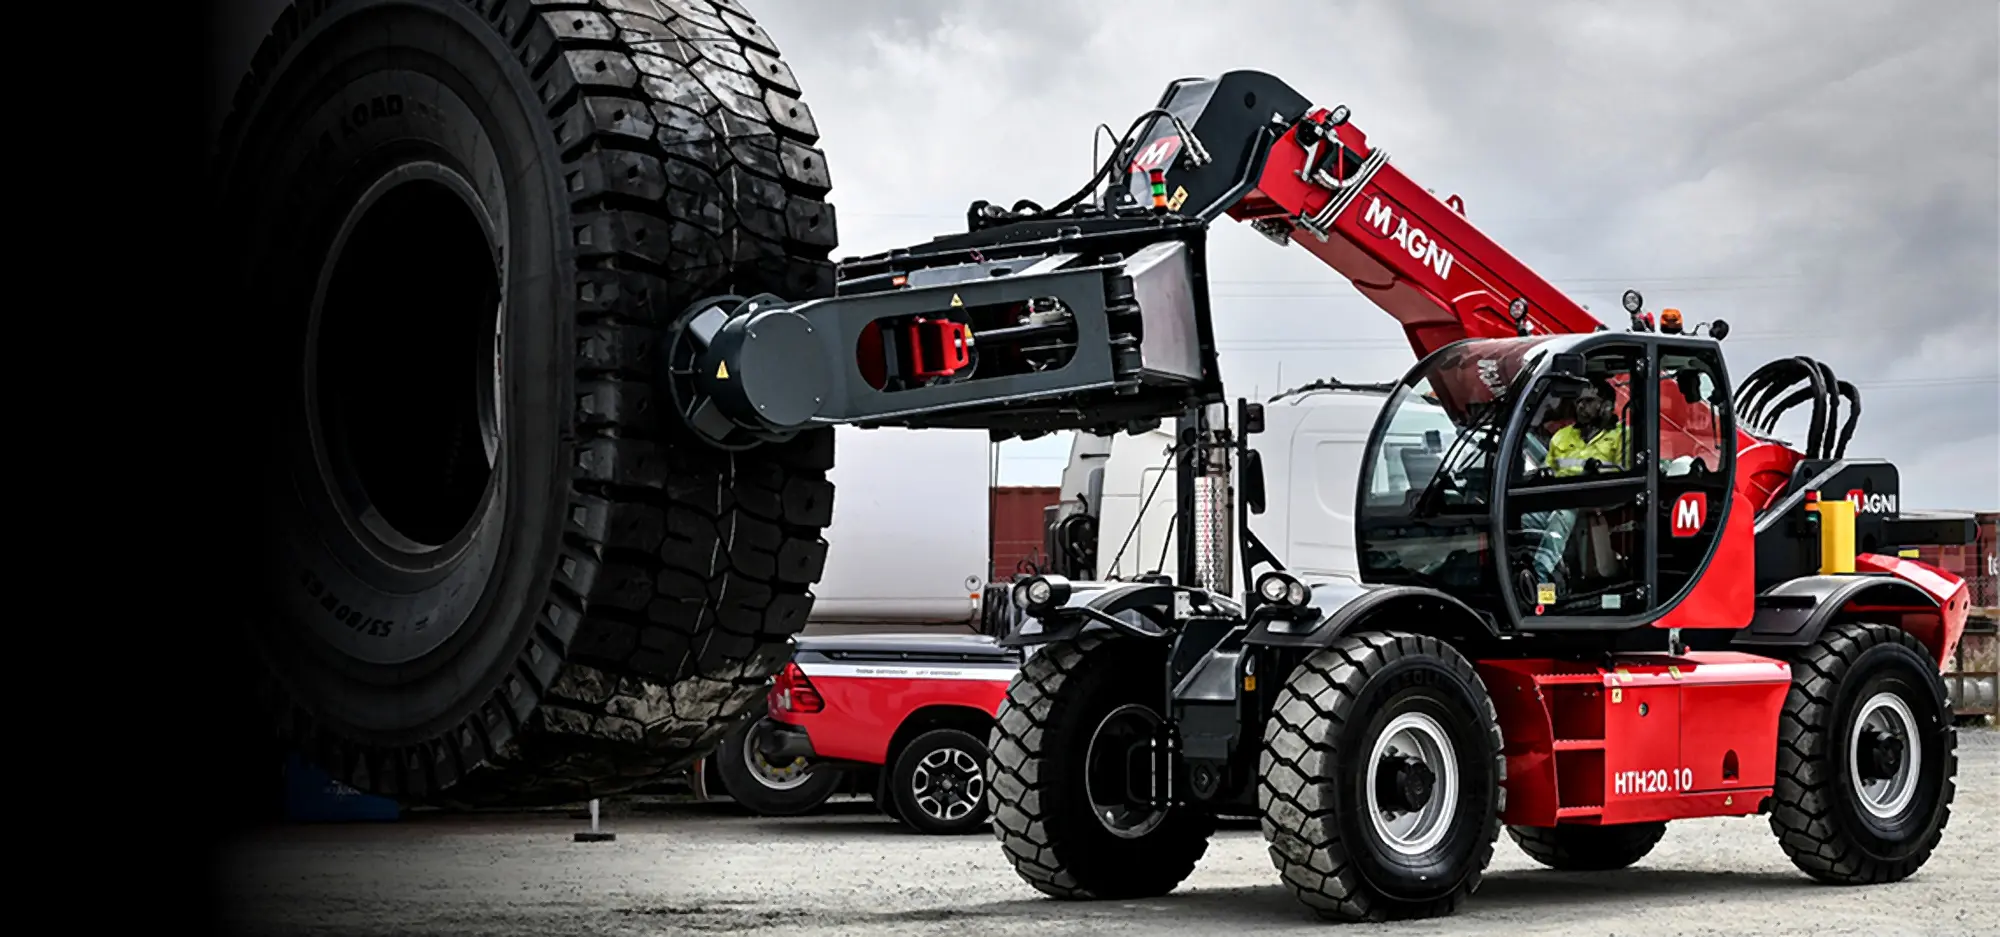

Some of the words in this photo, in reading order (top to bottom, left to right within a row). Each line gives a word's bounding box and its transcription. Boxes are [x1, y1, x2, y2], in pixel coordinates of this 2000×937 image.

[1137, 141, 1170, 166] M
[1364, 196, 1454, 280] MAGNI
[1676, 500, 1700, 529] M
[1615, 767, 1692, 794] HTH20.10
